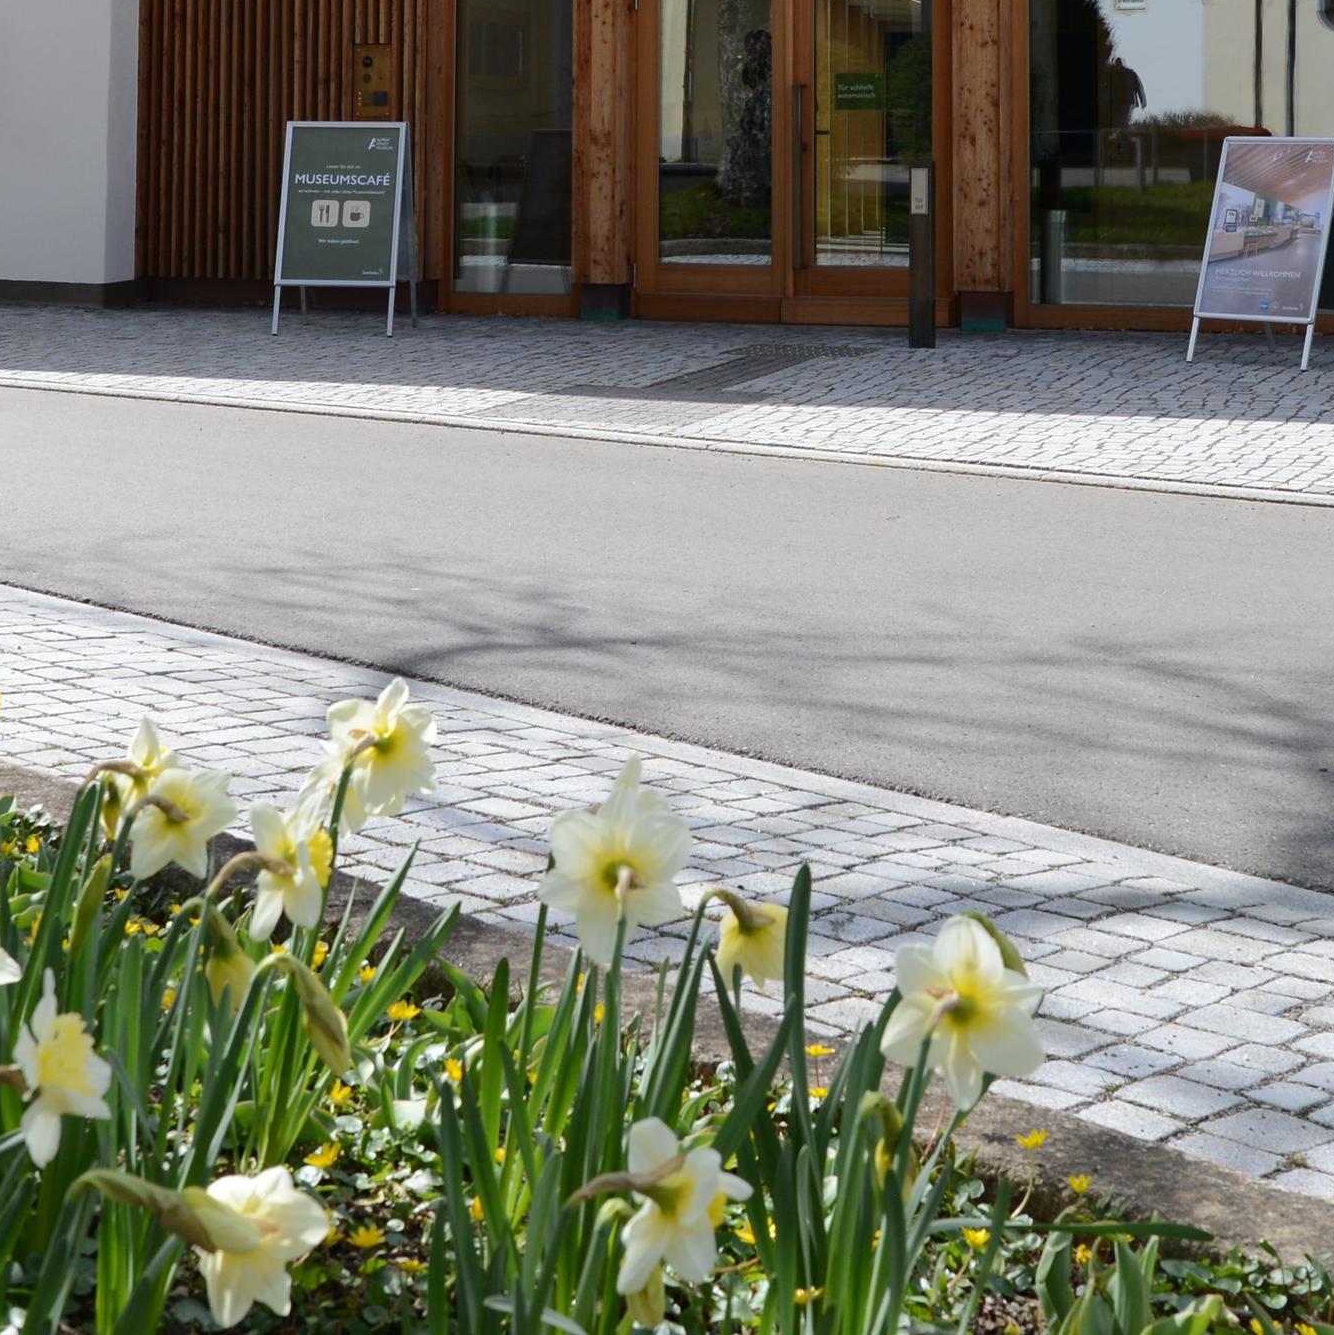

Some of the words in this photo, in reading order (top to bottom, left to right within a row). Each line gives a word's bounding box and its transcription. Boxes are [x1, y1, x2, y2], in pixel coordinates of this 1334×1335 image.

[295, 173, 391, 186] MUSEUMSCAFÉ
[1215, 267, 1251, 276] HERZLICH
[1252, 269, 1302, 278] WILLKOMMEN
